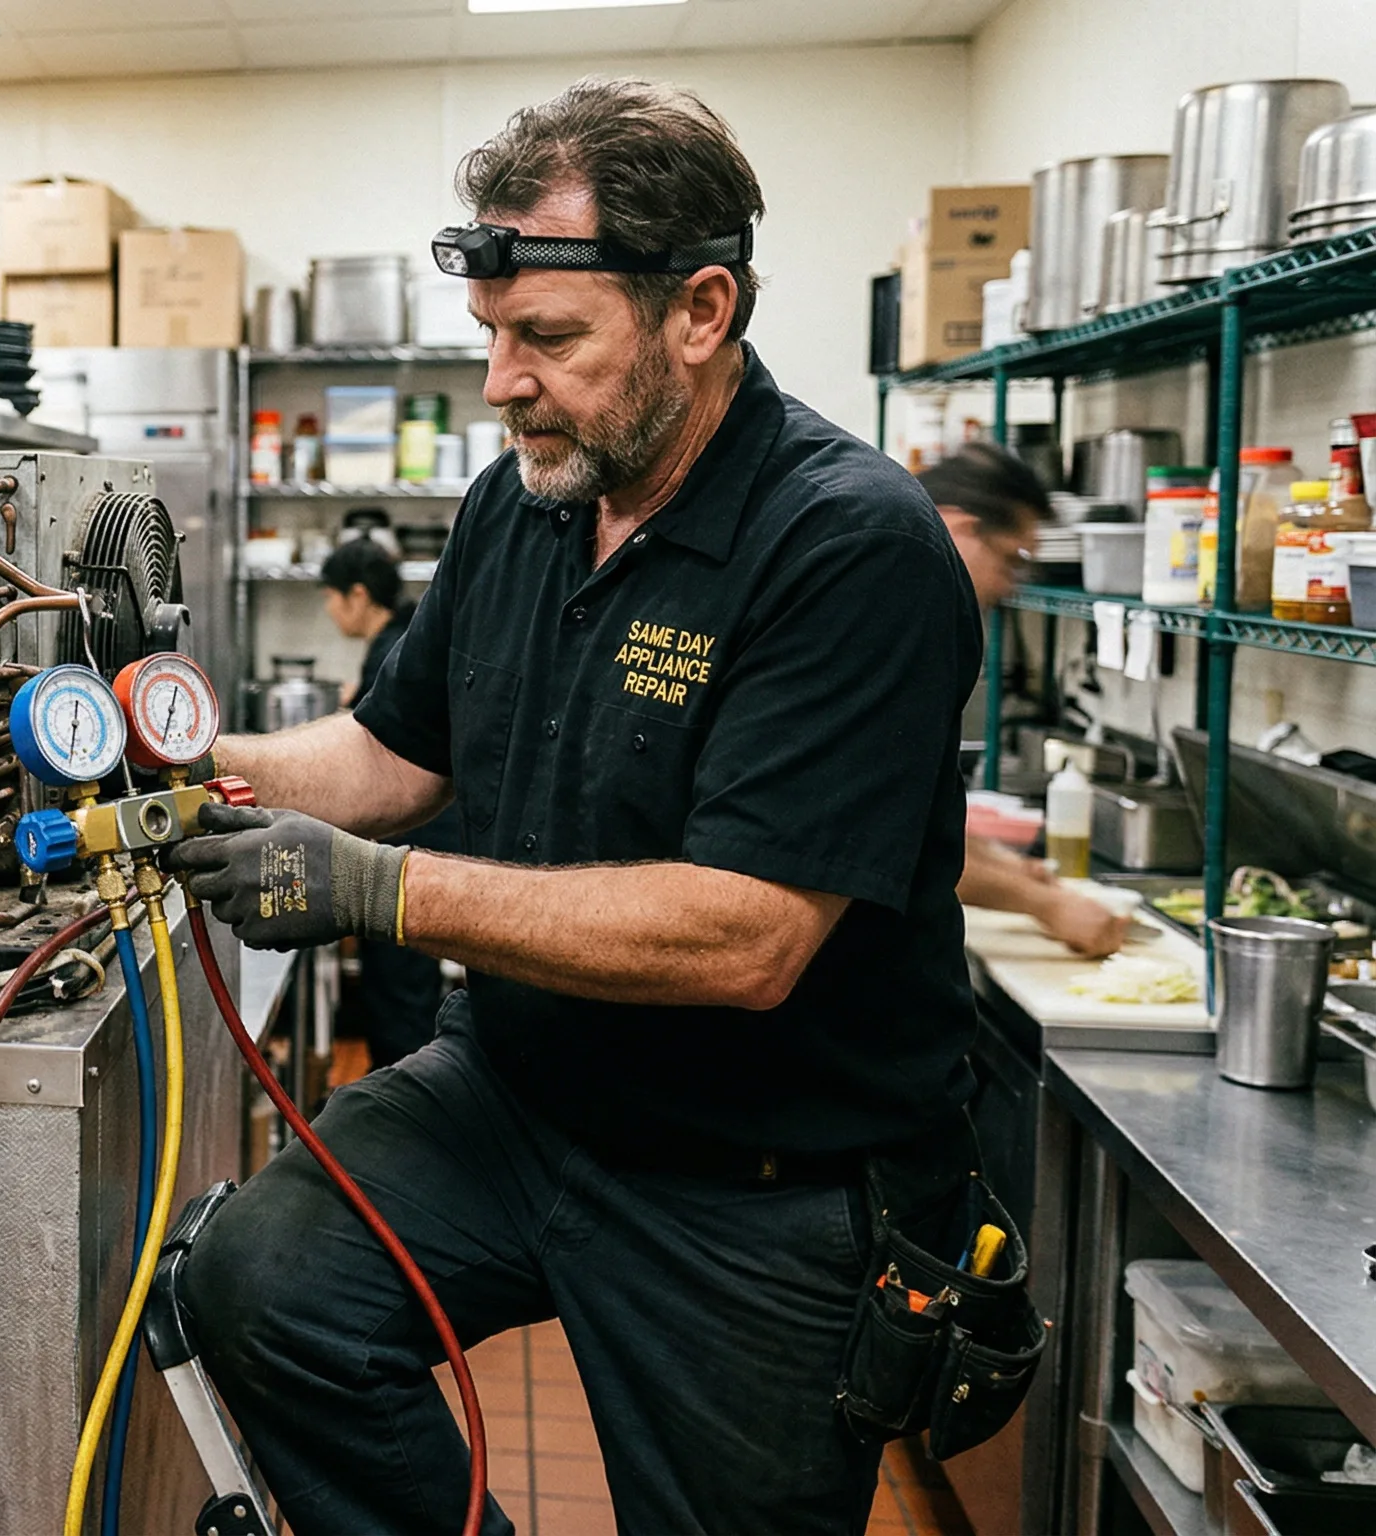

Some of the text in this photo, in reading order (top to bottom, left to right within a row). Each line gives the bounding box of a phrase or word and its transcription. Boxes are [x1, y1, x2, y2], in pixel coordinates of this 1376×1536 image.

[628, 620, 715, 657] SAME DAY
[614, 643, 711, 684] APPLIANCE
[624, 671, 687, 706] REPAIR
